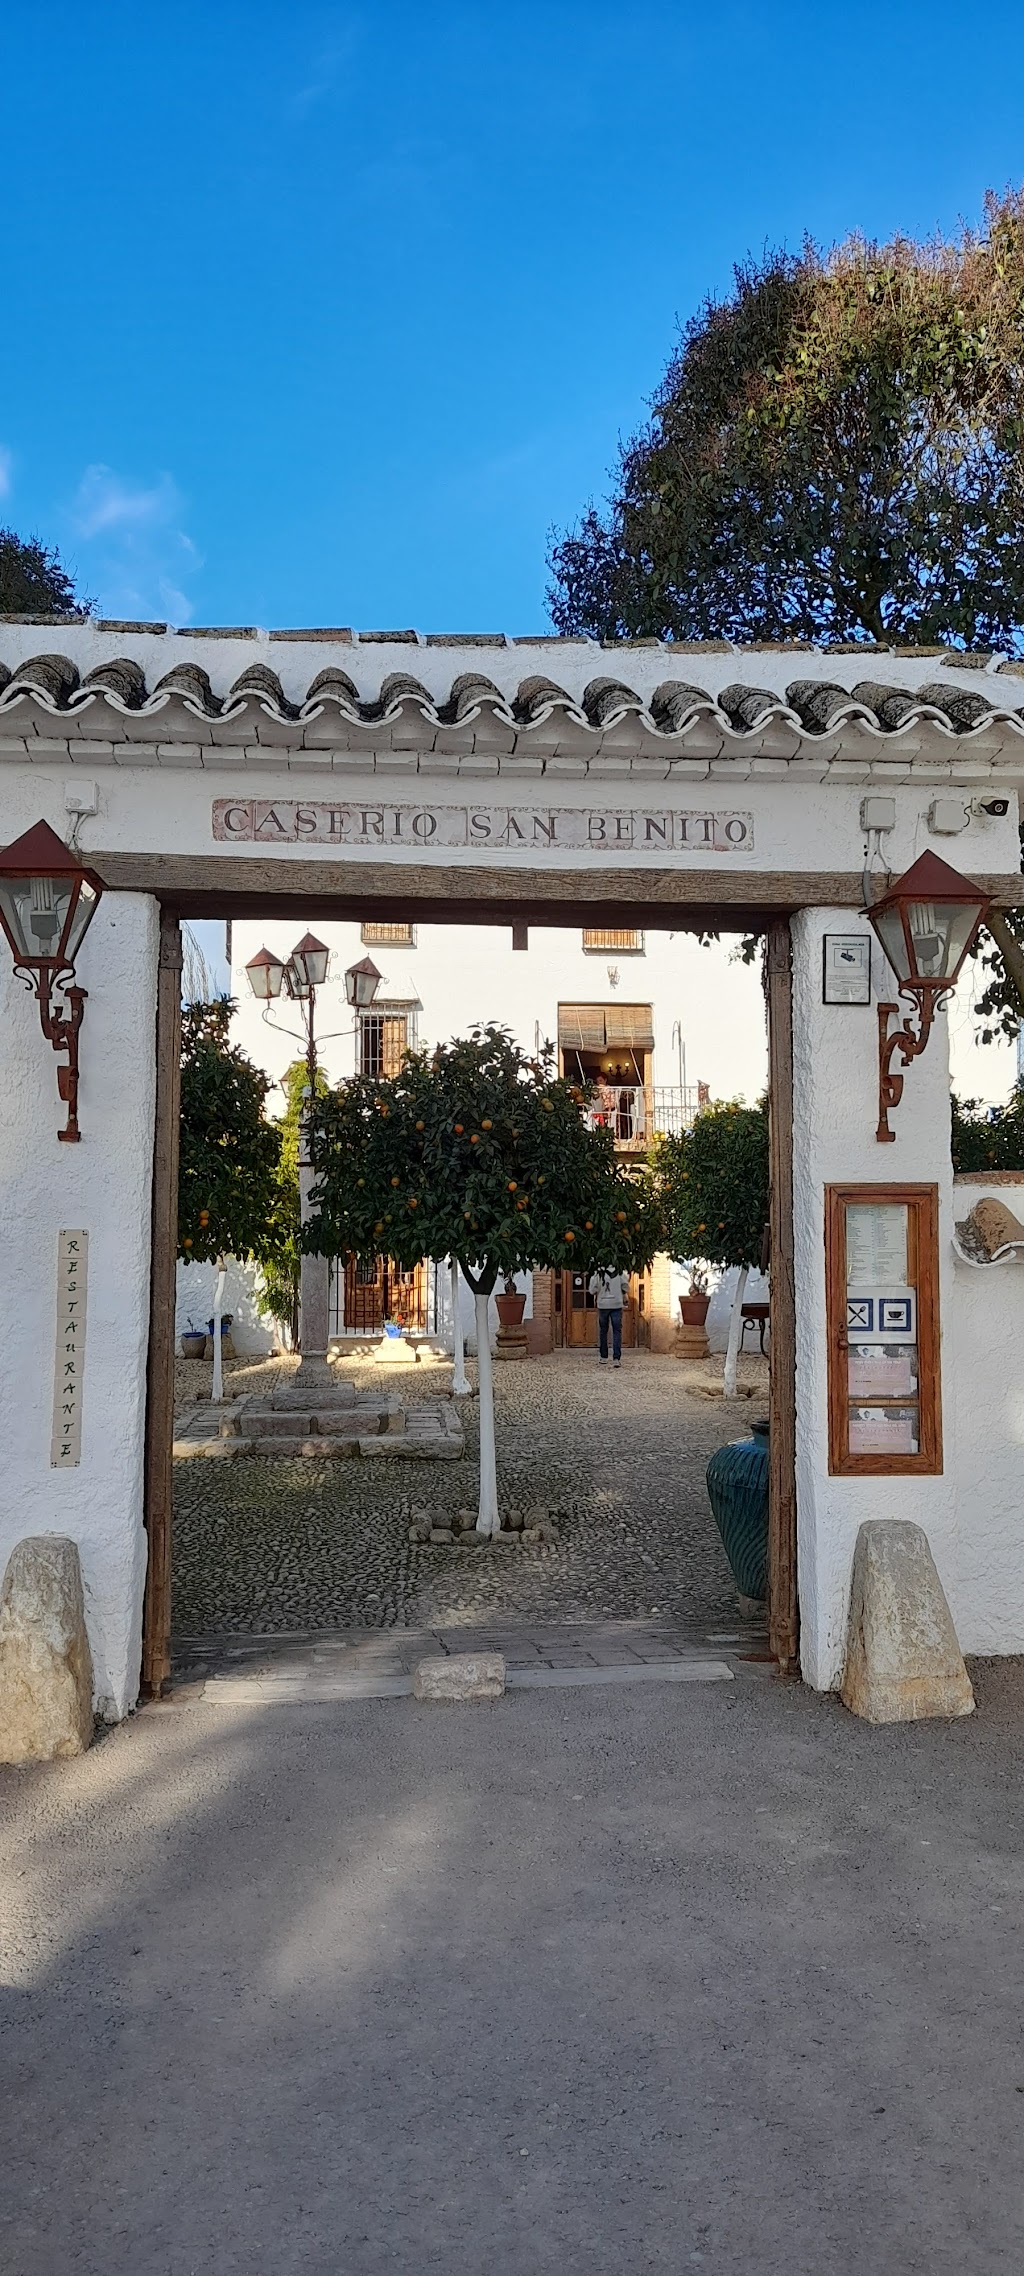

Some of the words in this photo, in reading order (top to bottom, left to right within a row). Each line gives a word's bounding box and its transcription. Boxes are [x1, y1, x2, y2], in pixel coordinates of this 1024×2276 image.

[470, 814, 559, 840] SAN
[586, 816, 748, 843] BENITO
[60, 1239, 80, 1457] RESTAURANTE
